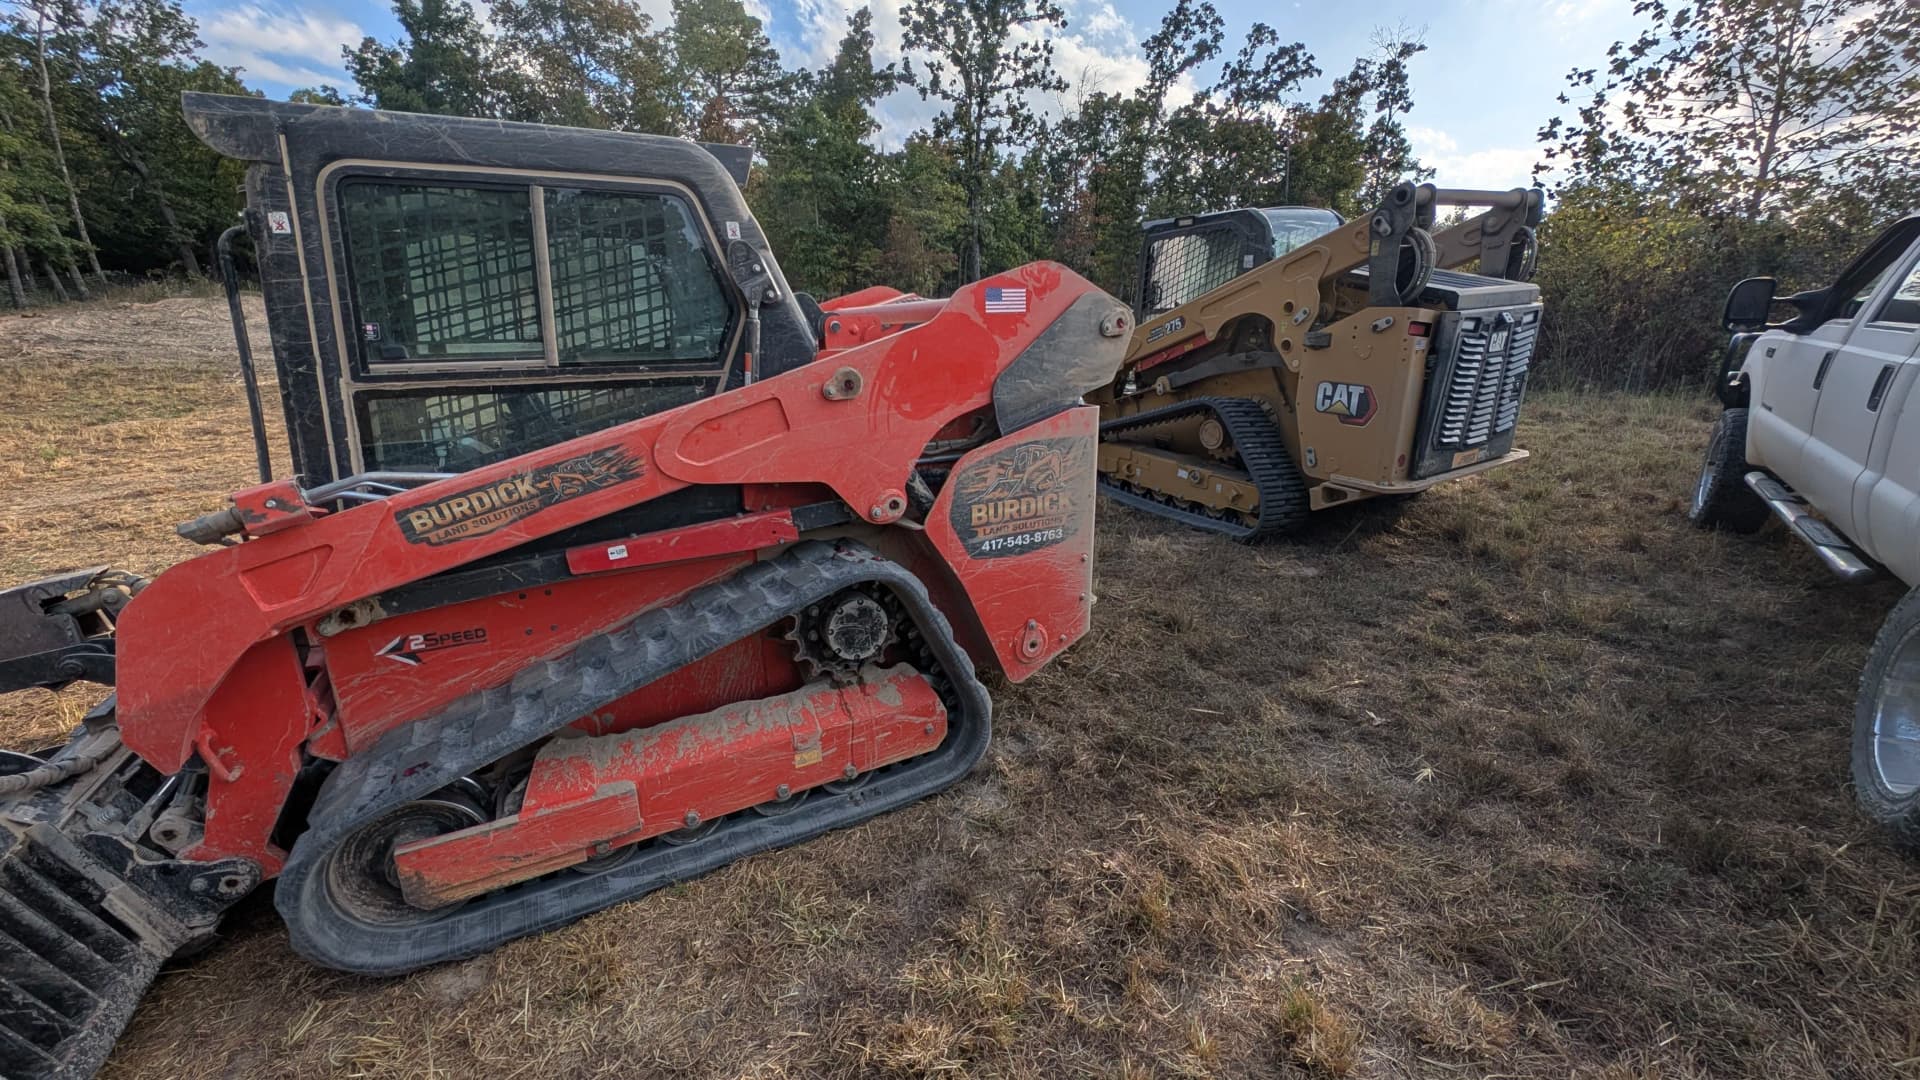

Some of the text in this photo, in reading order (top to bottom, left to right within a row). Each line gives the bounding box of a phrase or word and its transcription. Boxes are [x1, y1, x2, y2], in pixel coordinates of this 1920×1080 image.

[1165, 317, 1182, 334] 275
[1489, 331, 1508, 352] CAT
[1316, 382, 1364, 416] CAT
[408, 478, 538, 534] BURDICK
[971, 493, 1071, 527] BURDICK
[436, 502, 537, 542] LAND SOLUTIONS
[983, 525, 1009, 536] LAND
[981, 528, 1063, 551] 417-543-8763
